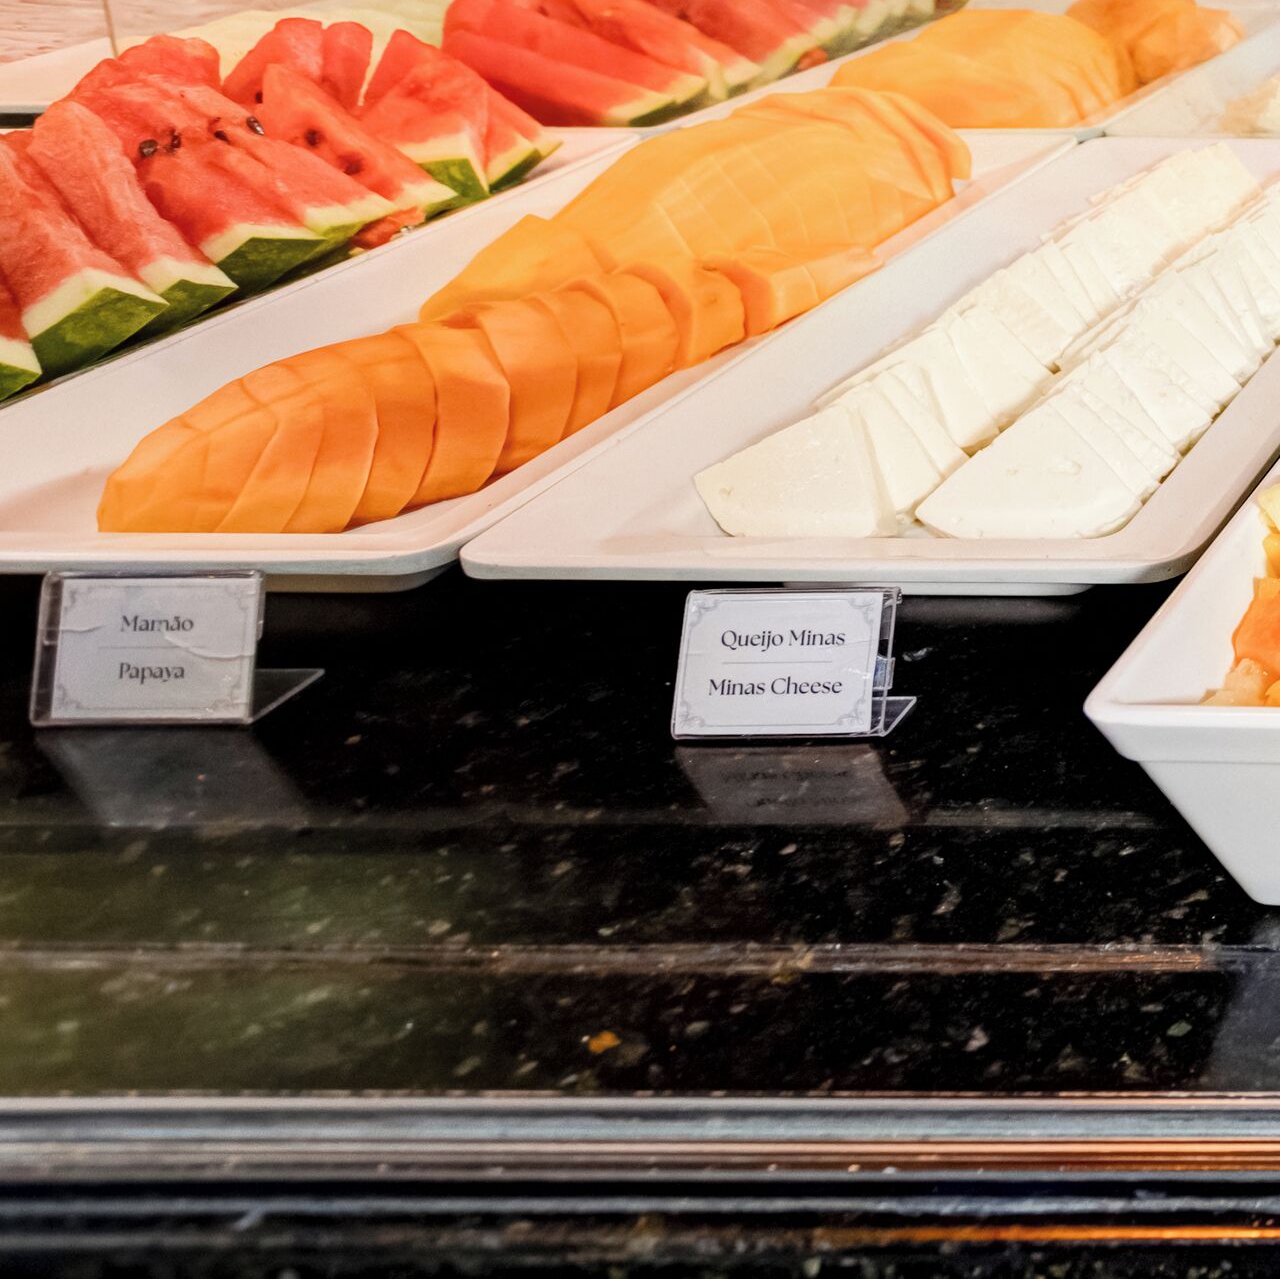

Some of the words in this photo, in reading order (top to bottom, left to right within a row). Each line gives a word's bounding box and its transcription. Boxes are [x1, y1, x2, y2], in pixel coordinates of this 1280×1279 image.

[720, 629, 784, 652] Queijo
[788, 629, 846, 647] Minas
[118, 662, 185, 684] Papaya
[708, 678, 765, 696] Minas
[770, 676, 843, 695] Cheese
